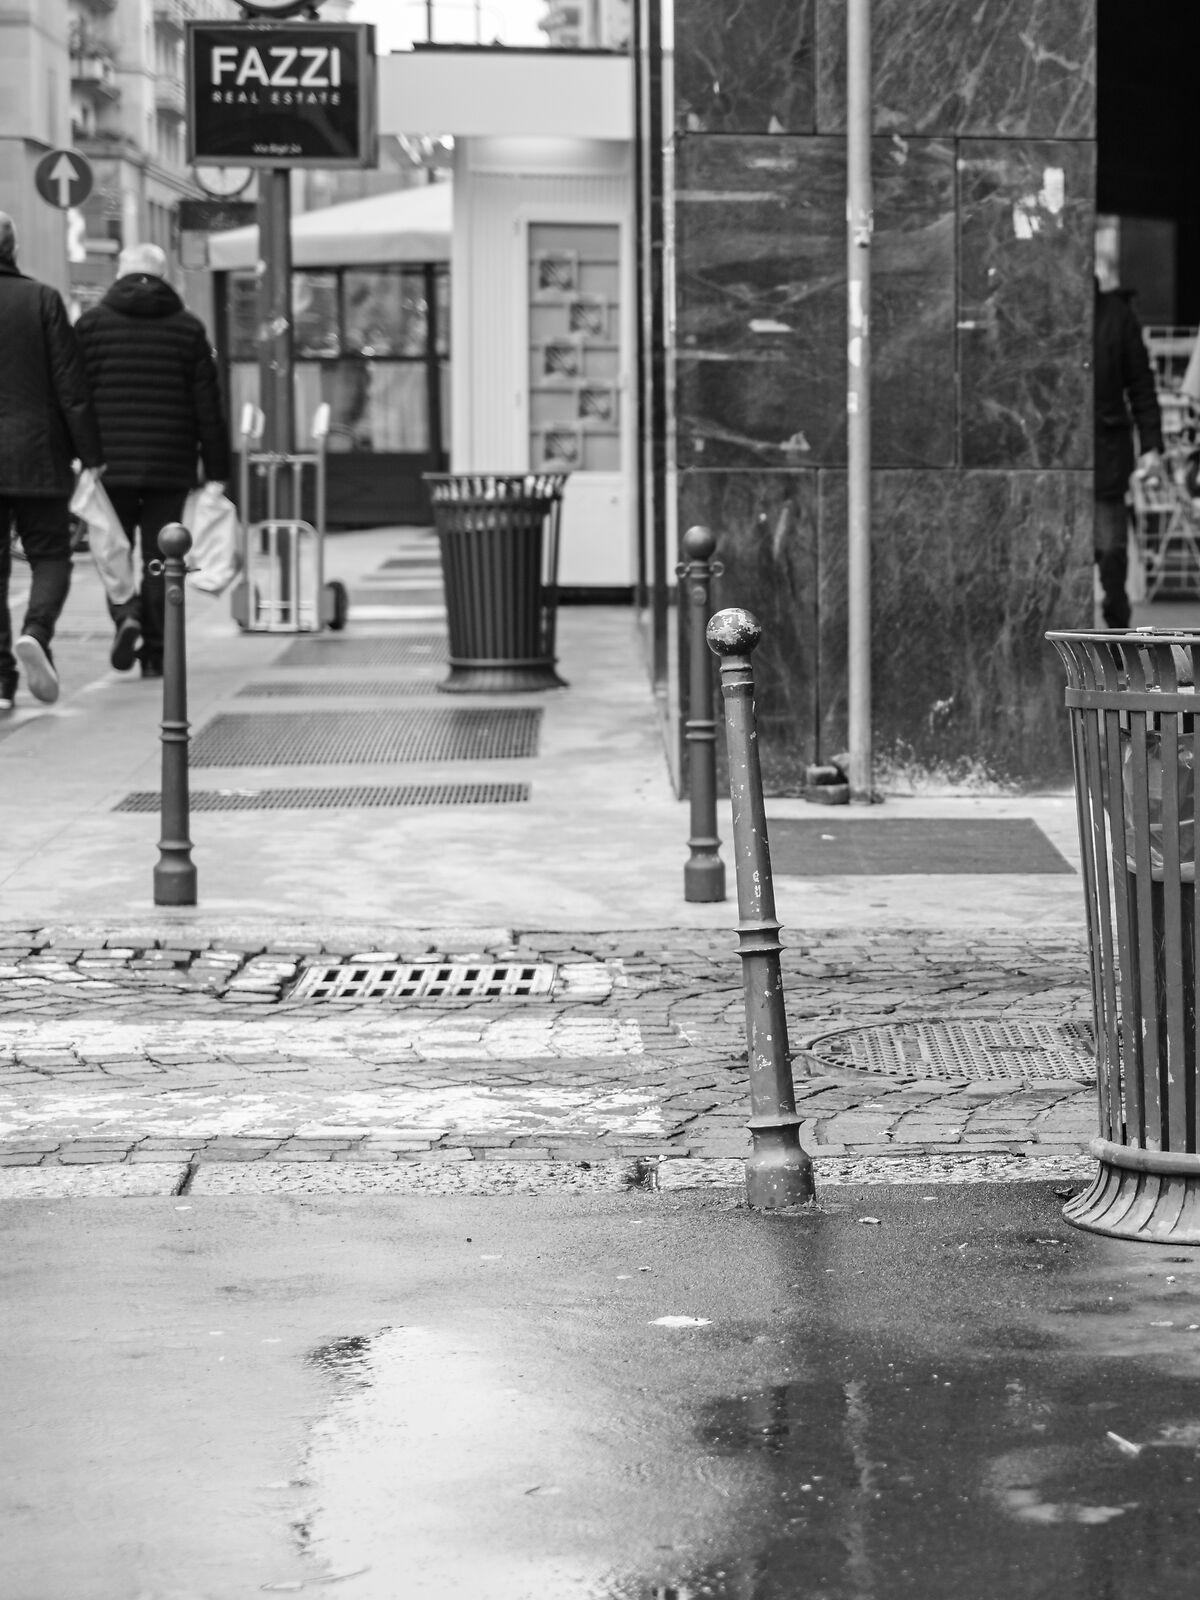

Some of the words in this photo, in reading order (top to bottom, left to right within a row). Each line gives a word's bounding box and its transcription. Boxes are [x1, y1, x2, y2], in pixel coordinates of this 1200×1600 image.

[211, 46, 341, 87] FAZZI
[212, 90, 260, 104] REAL
[271, 90, 341, 106] ESTATE
